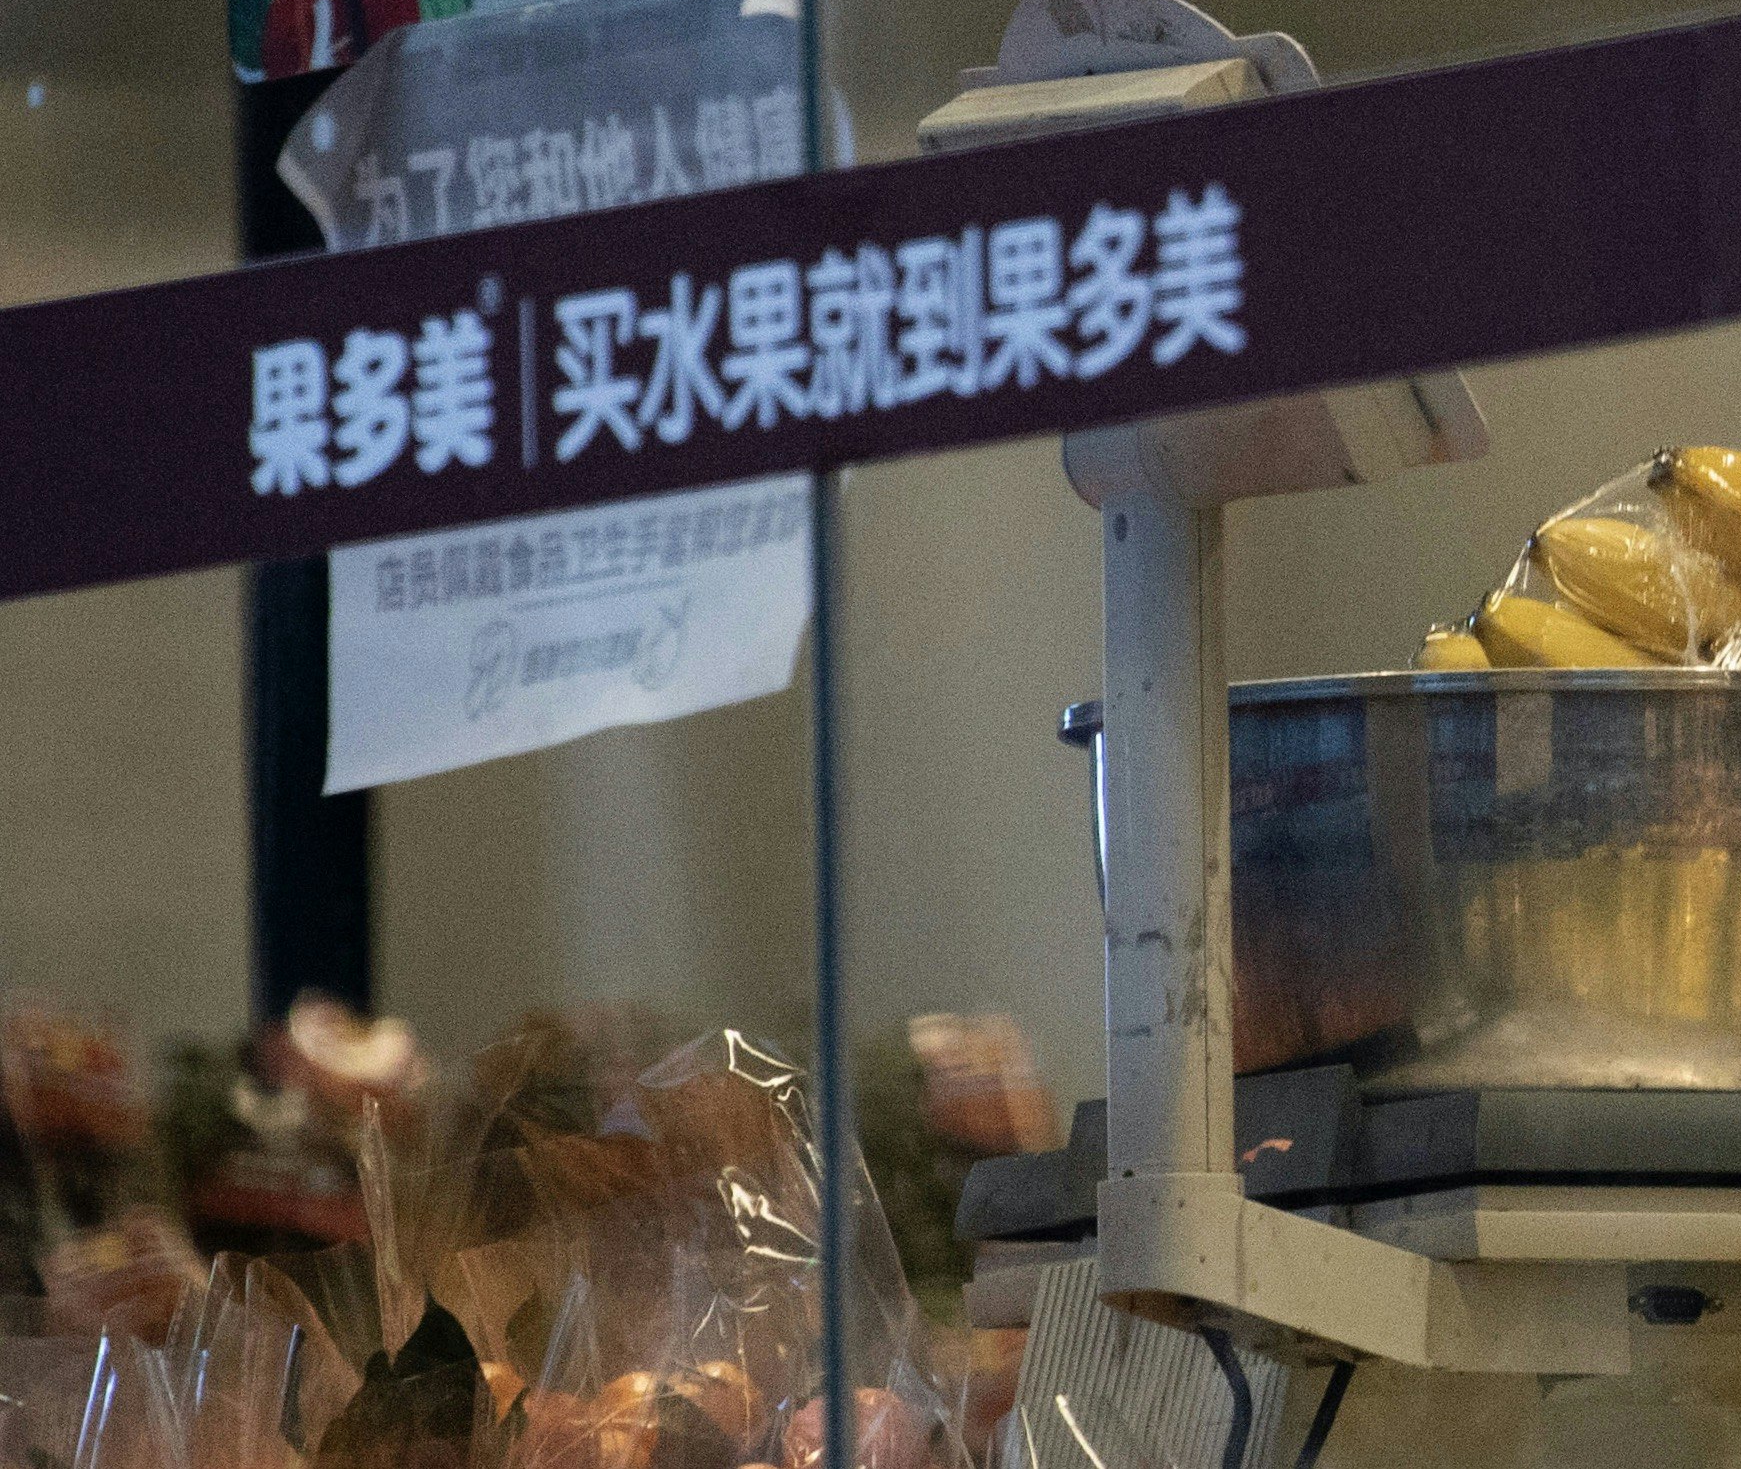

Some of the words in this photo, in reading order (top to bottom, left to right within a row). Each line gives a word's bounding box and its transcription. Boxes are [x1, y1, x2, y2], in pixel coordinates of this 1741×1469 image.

[248, 306, 498, 499] 果多美
[550, 182, 1250, 467] 买水果就到果多美
